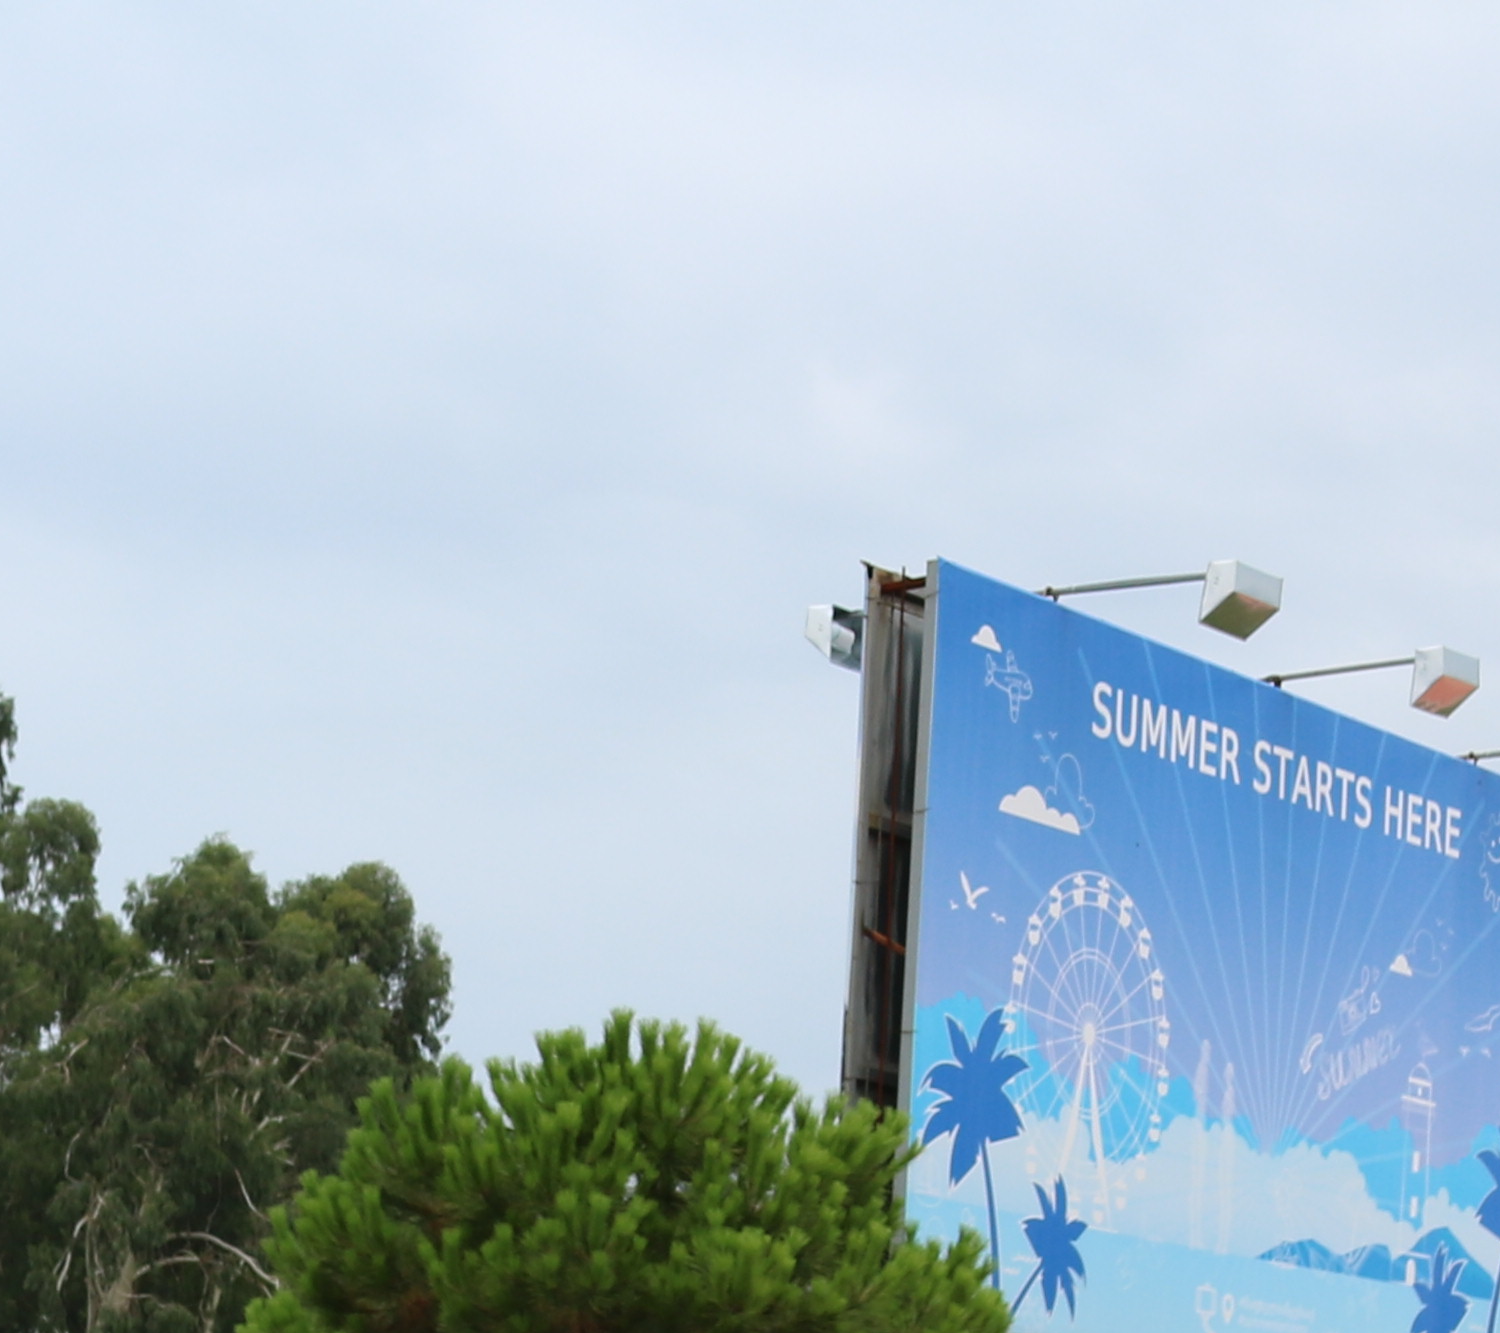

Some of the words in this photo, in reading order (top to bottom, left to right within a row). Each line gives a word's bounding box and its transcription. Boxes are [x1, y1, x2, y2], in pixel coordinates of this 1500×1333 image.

[1091, 680, 1241, 786] SUMMER
[1252, 739, 1373, 831] STARTS
[1383, 785, 1462, 860] HERE
